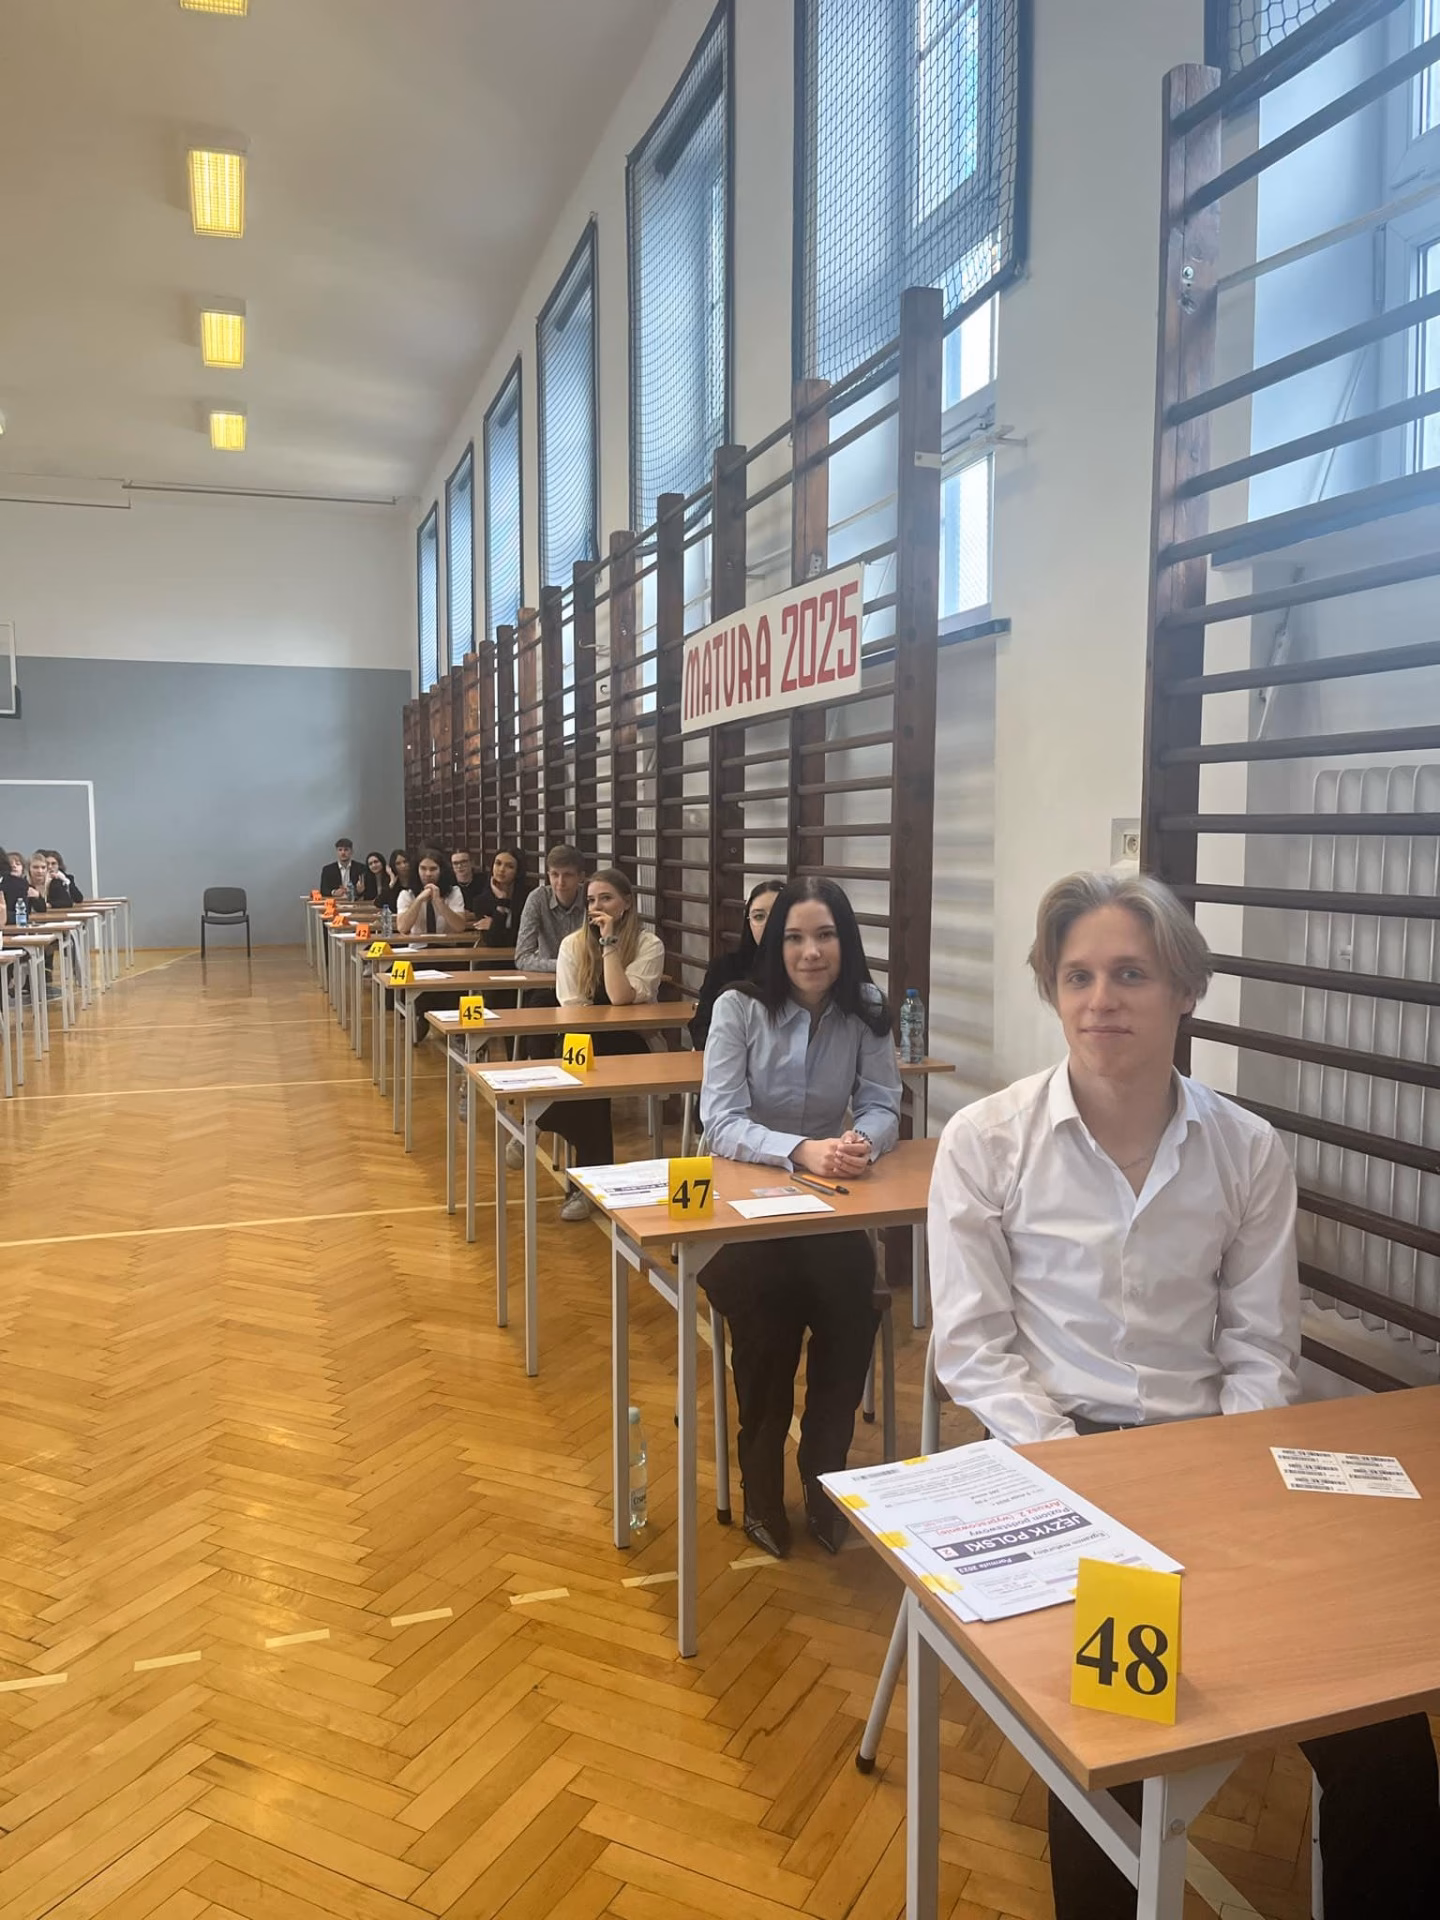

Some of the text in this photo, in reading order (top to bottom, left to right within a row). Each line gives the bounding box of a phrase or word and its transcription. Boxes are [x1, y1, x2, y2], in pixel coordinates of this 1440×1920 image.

[685, 580, 858, 721] MATURA 2025
[392, 968, 406, 980] 44
[463, 1006, 483, 1020] 45
[563, 1047, 586, 1065] 46
[672, 1179, 711, 1209] 47
[1028, 1515, 1081, 1538] JĘZYK
[965, 1530, 1029, 1552] POLSKI
[1076, 1617, 1168, 1695] 48
